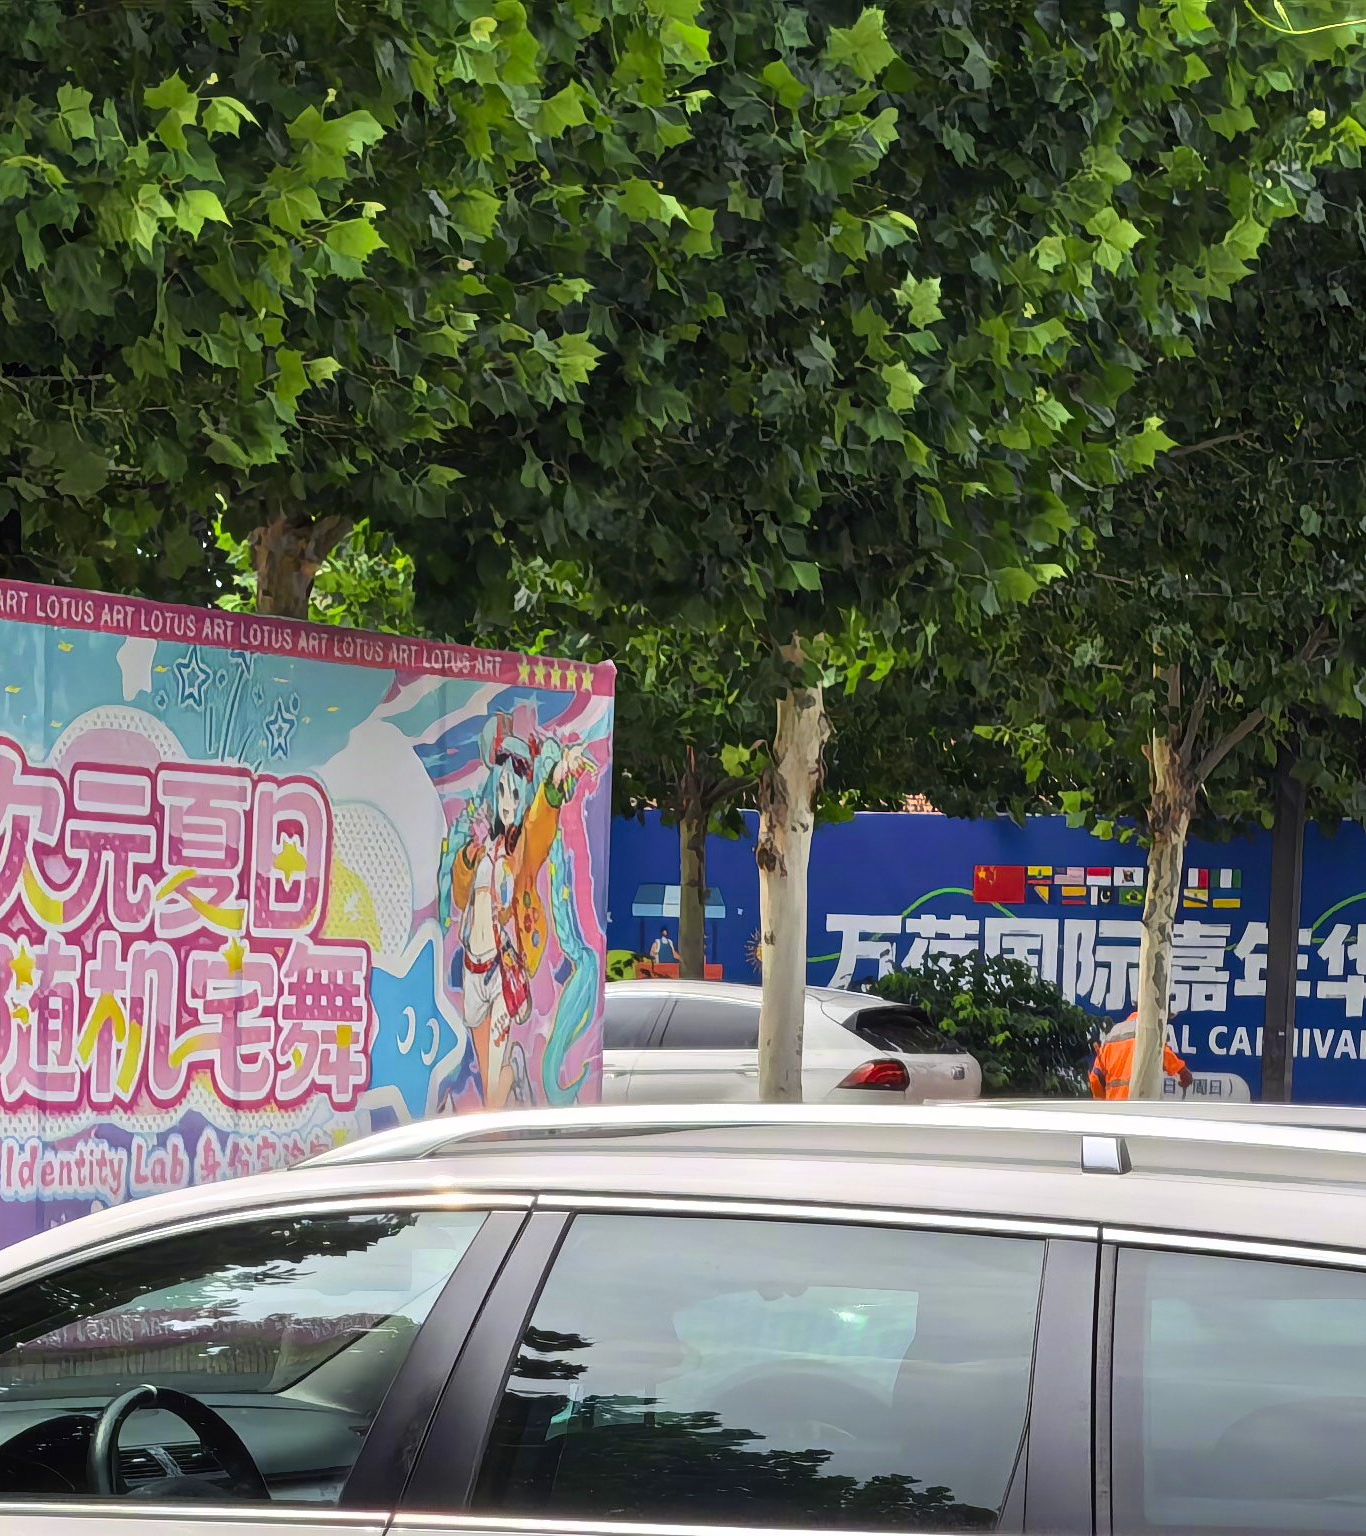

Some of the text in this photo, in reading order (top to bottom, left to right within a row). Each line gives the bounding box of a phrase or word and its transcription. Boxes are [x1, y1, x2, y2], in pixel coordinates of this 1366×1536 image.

[36, 594, 95, 624] LOTUS
[100, 603, 136, 630] ART
[140, 609, 197, 637] LOTUS
[201, 617, 235, 642] ART
[240, 623, 293, 650] LOTUS
[297, 630, 330, 655] ART
[332, 635, 384, 662] LOTUS
[388, 642, 419, 667] ART
[422, 648, 471, 674] LOTUS
[474, 655, 502, 677] ART
[5, 1143, 124, 1197] Identity
[134, 1142, 186, 1186] Lab
